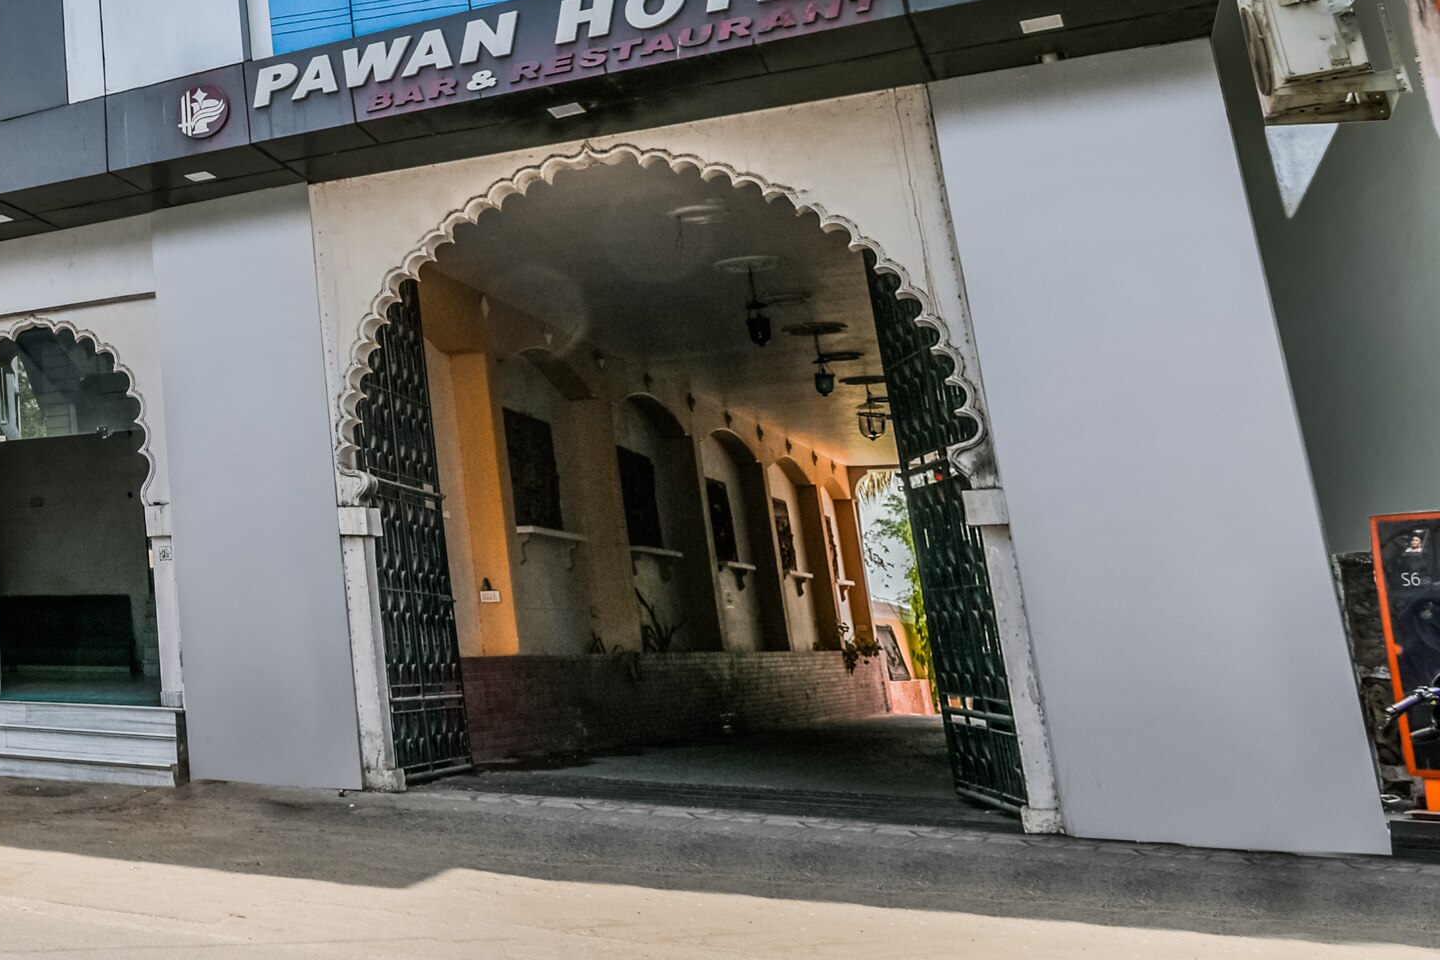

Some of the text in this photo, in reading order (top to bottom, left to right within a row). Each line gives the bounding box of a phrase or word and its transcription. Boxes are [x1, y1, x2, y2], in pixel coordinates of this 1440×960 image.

[253, 11, 518, 108] PAWAN
[366, 77, 457, 112] BAR
[466, 70, 498, 91] &
